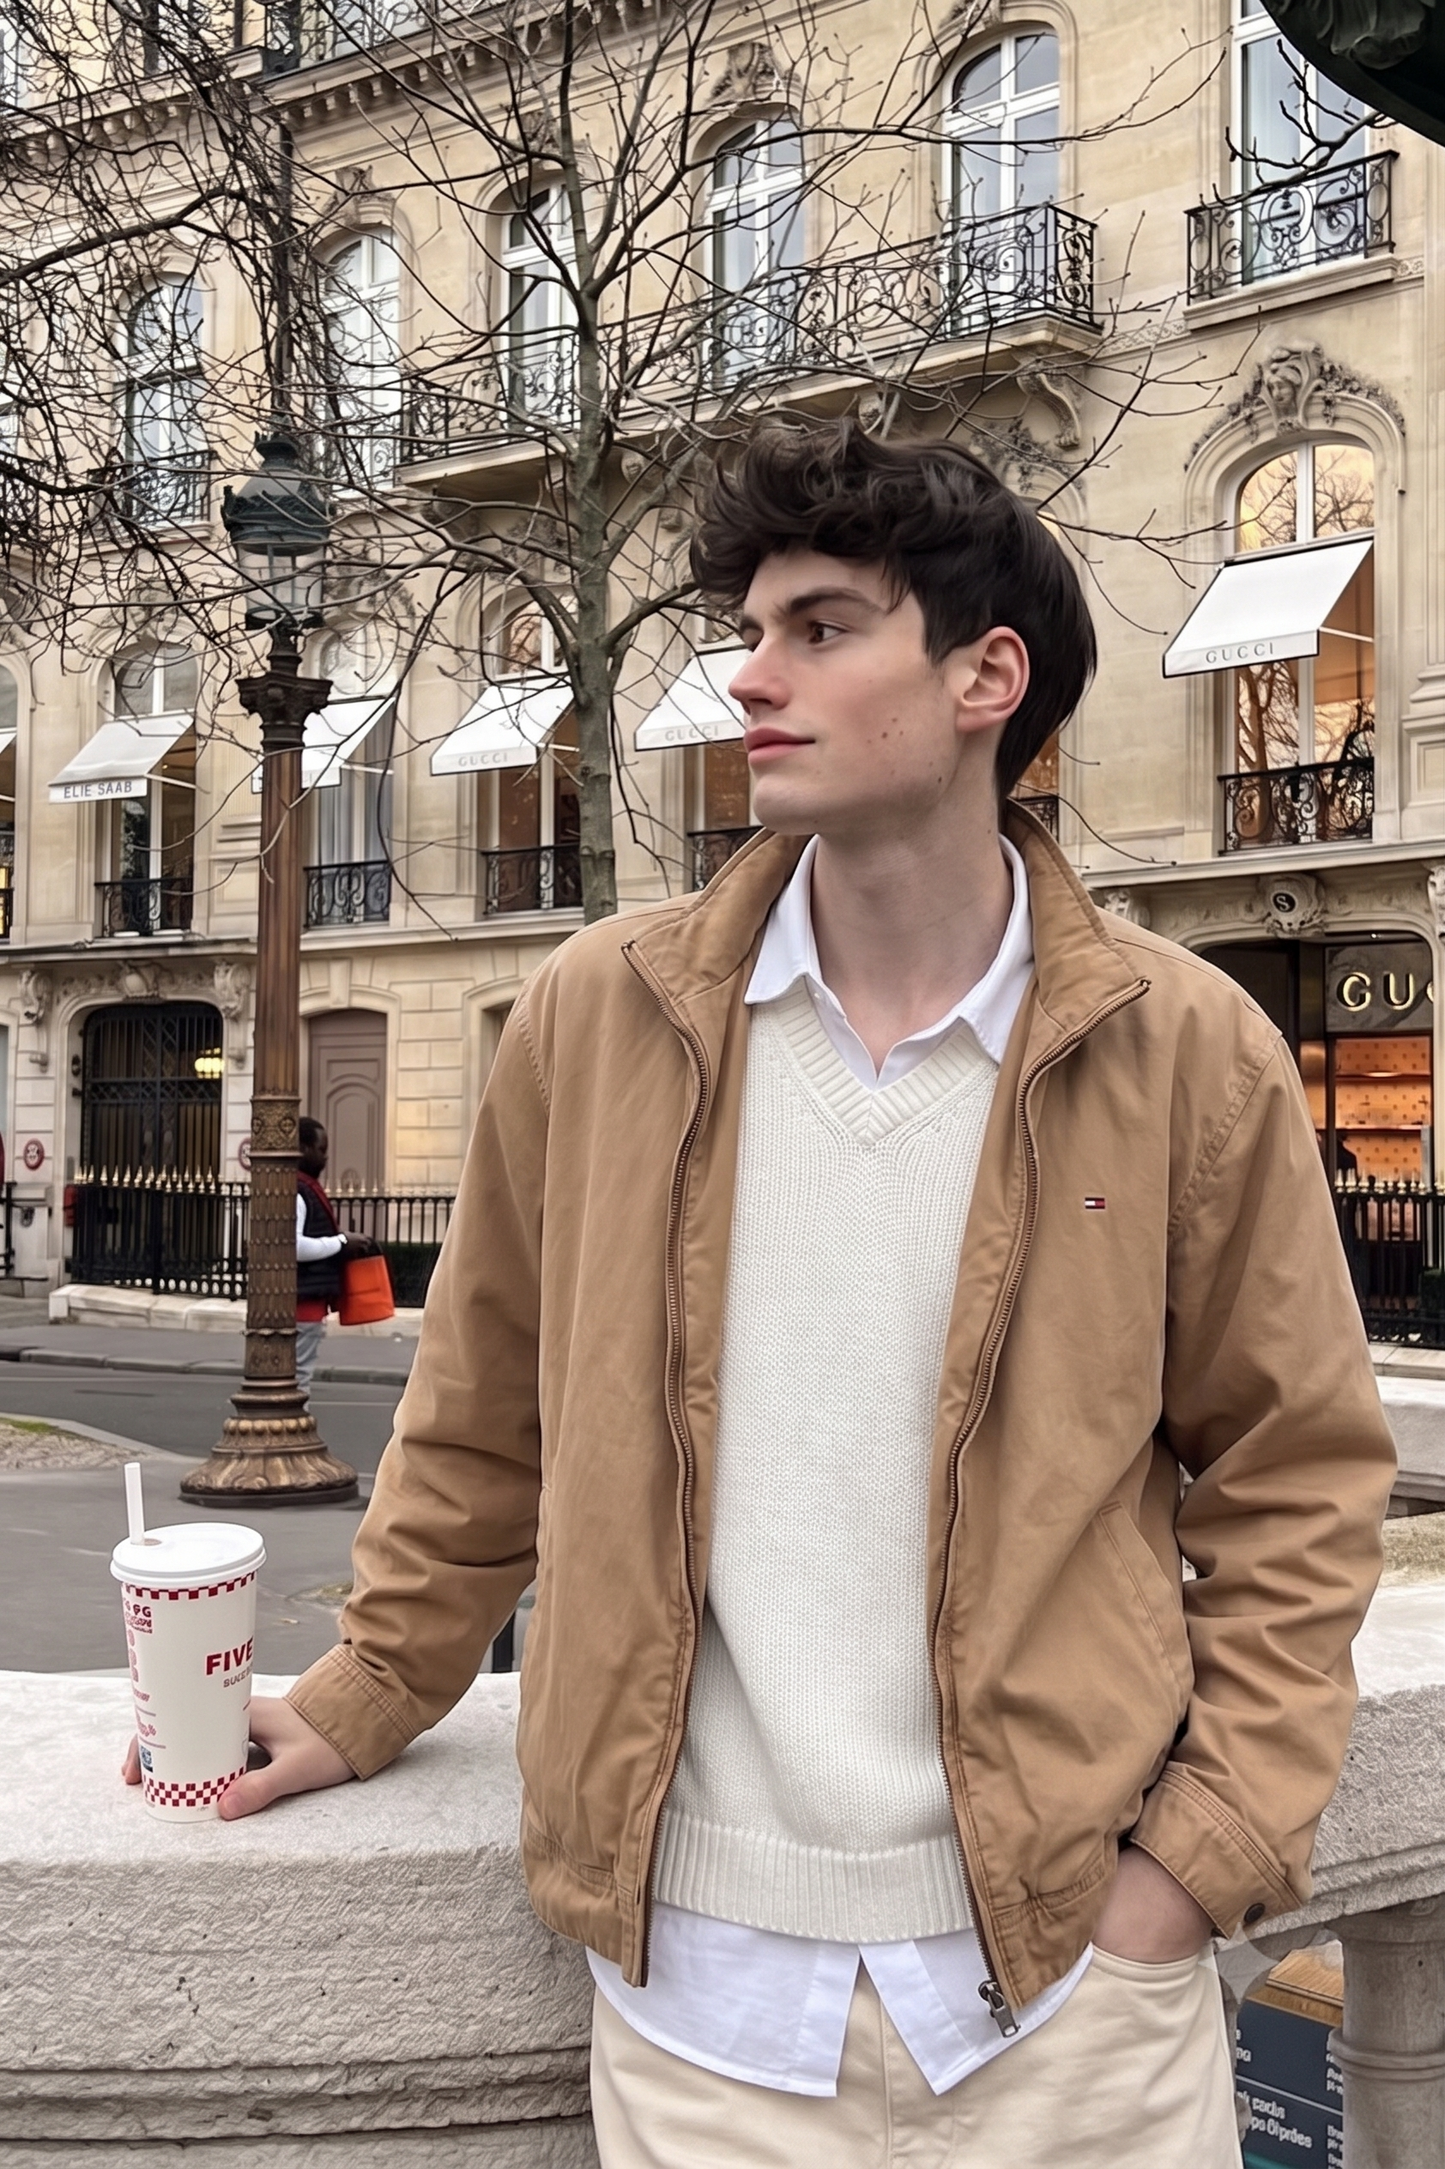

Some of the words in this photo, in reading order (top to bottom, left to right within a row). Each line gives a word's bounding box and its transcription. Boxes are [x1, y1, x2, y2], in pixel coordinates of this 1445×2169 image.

[1205, 642, 1274, 664] GUCCI
[664, 725, 719, 741] GUCCI
[458, 752, 508, 767] GUCCI
[63, 784, 92, 799] ELIE
[97, 781, 132, 796] SAAB
[206, 1635, 253, 1675] FIVE
